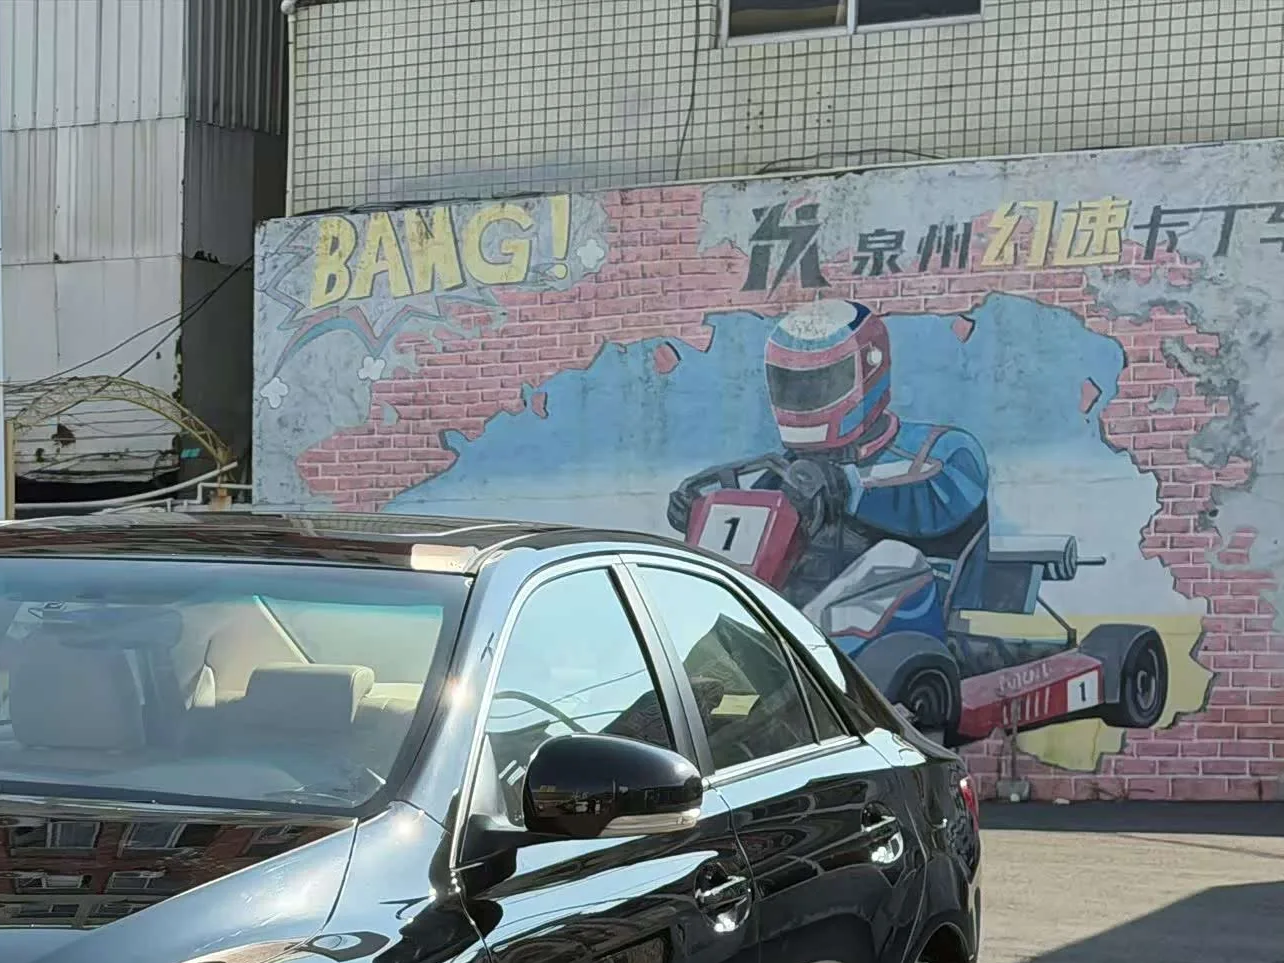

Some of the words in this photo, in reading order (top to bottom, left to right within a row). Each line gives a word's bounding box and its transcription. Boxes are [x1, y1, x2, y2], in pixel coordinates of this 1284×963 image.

[310, 193, 571, 309] BANG!
[722, 516, 741, 551] 1
[1078, 681, 1087, 703] 1
